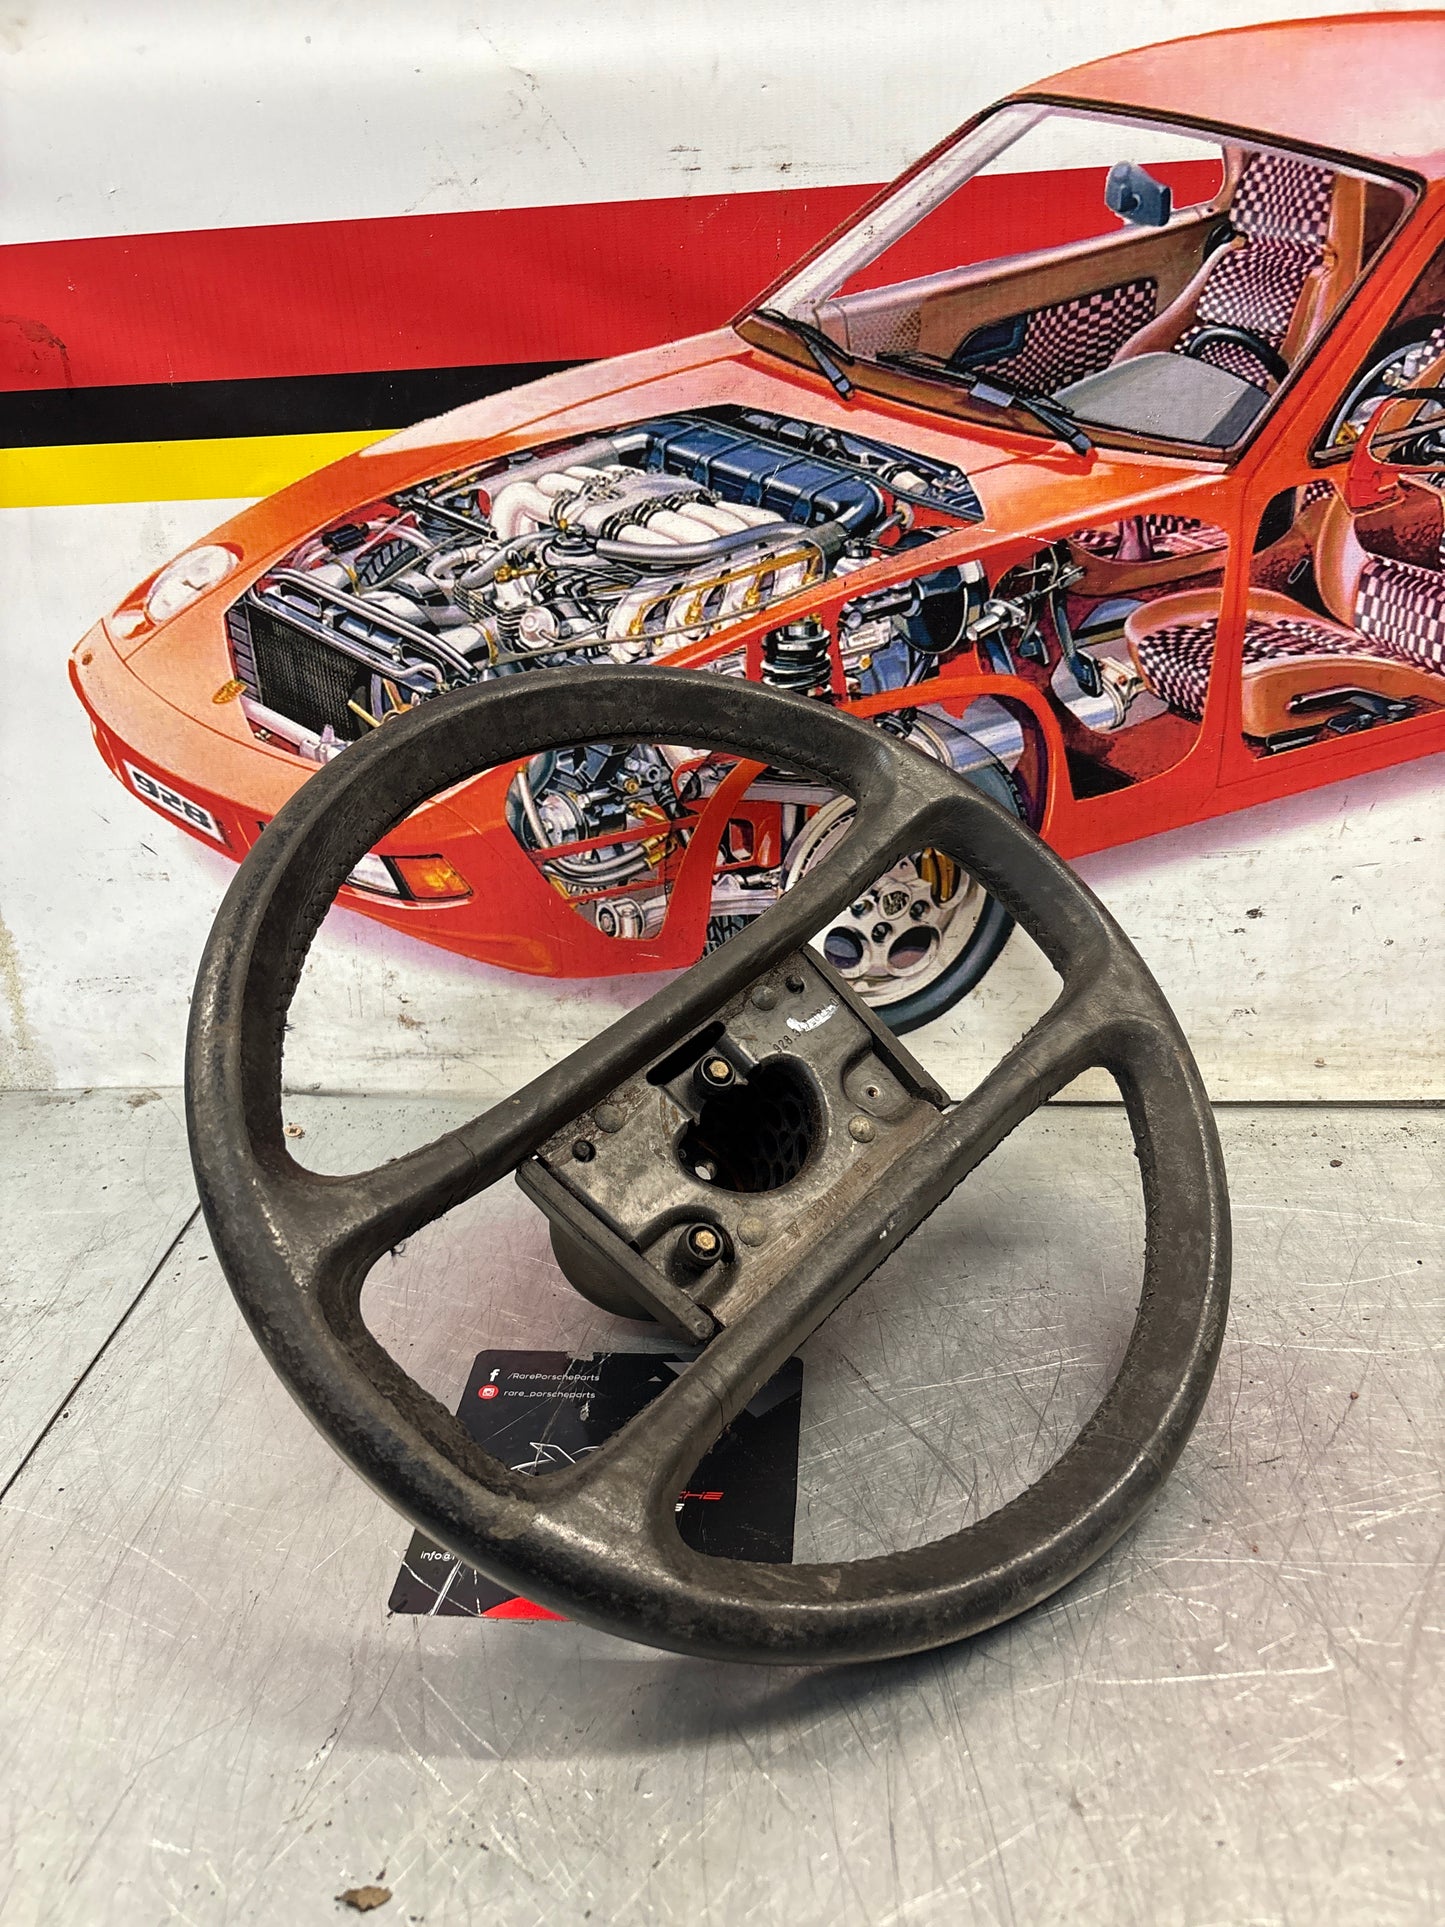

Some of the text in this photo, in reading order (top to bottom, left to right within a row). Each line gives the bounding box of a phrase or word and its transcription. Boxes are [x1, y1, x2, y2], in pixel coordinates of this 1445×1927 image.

[132, 770, 212, 830] 928
[507, 1372, 600, 1382] /RarePorscheParts
[503, 1389, 596, 1400] rare_porscheparts
